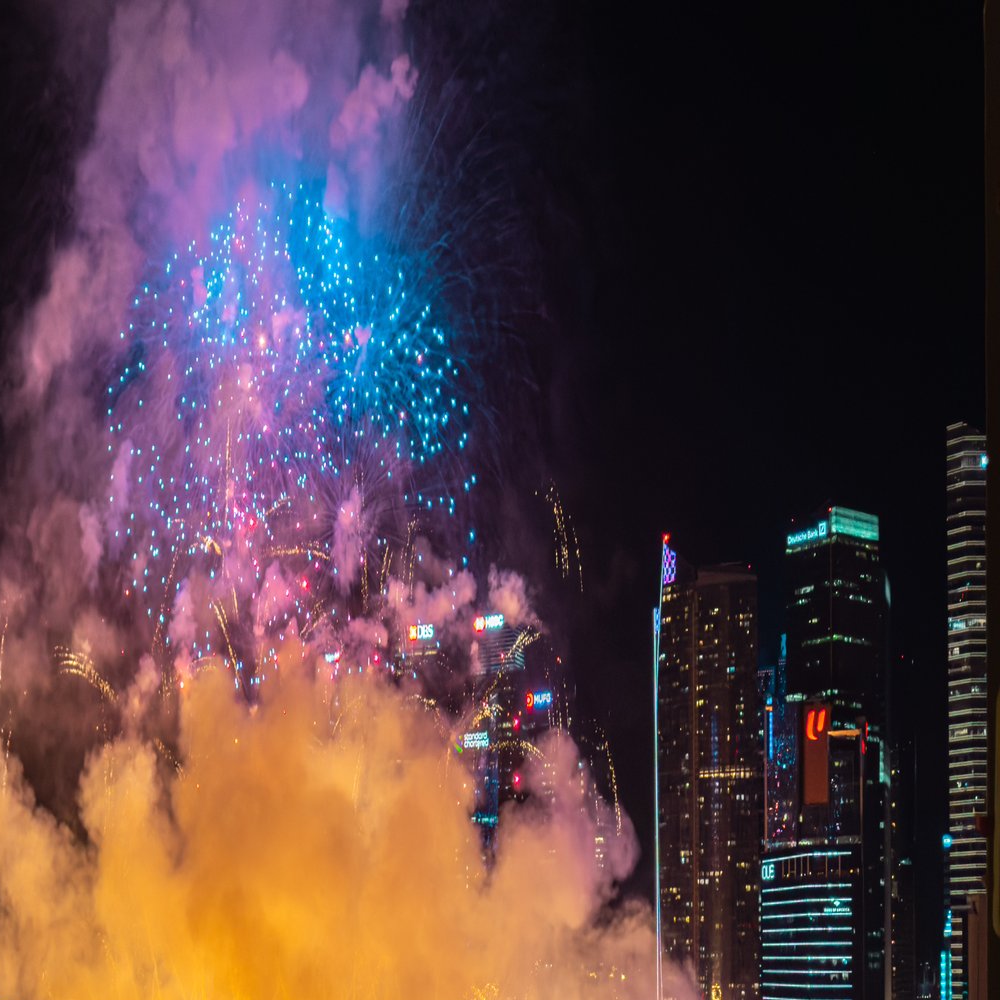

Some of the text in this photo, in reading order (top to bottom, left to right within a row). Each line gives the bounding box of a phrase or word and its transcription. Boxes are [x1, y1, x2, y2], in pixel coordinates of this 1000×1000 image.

[417, 624, 434, 639] DBS
[463, 730, 489, 741] standard
[463, 738, 490, 750] chartered
[761, 864, 775, 881] OUE
